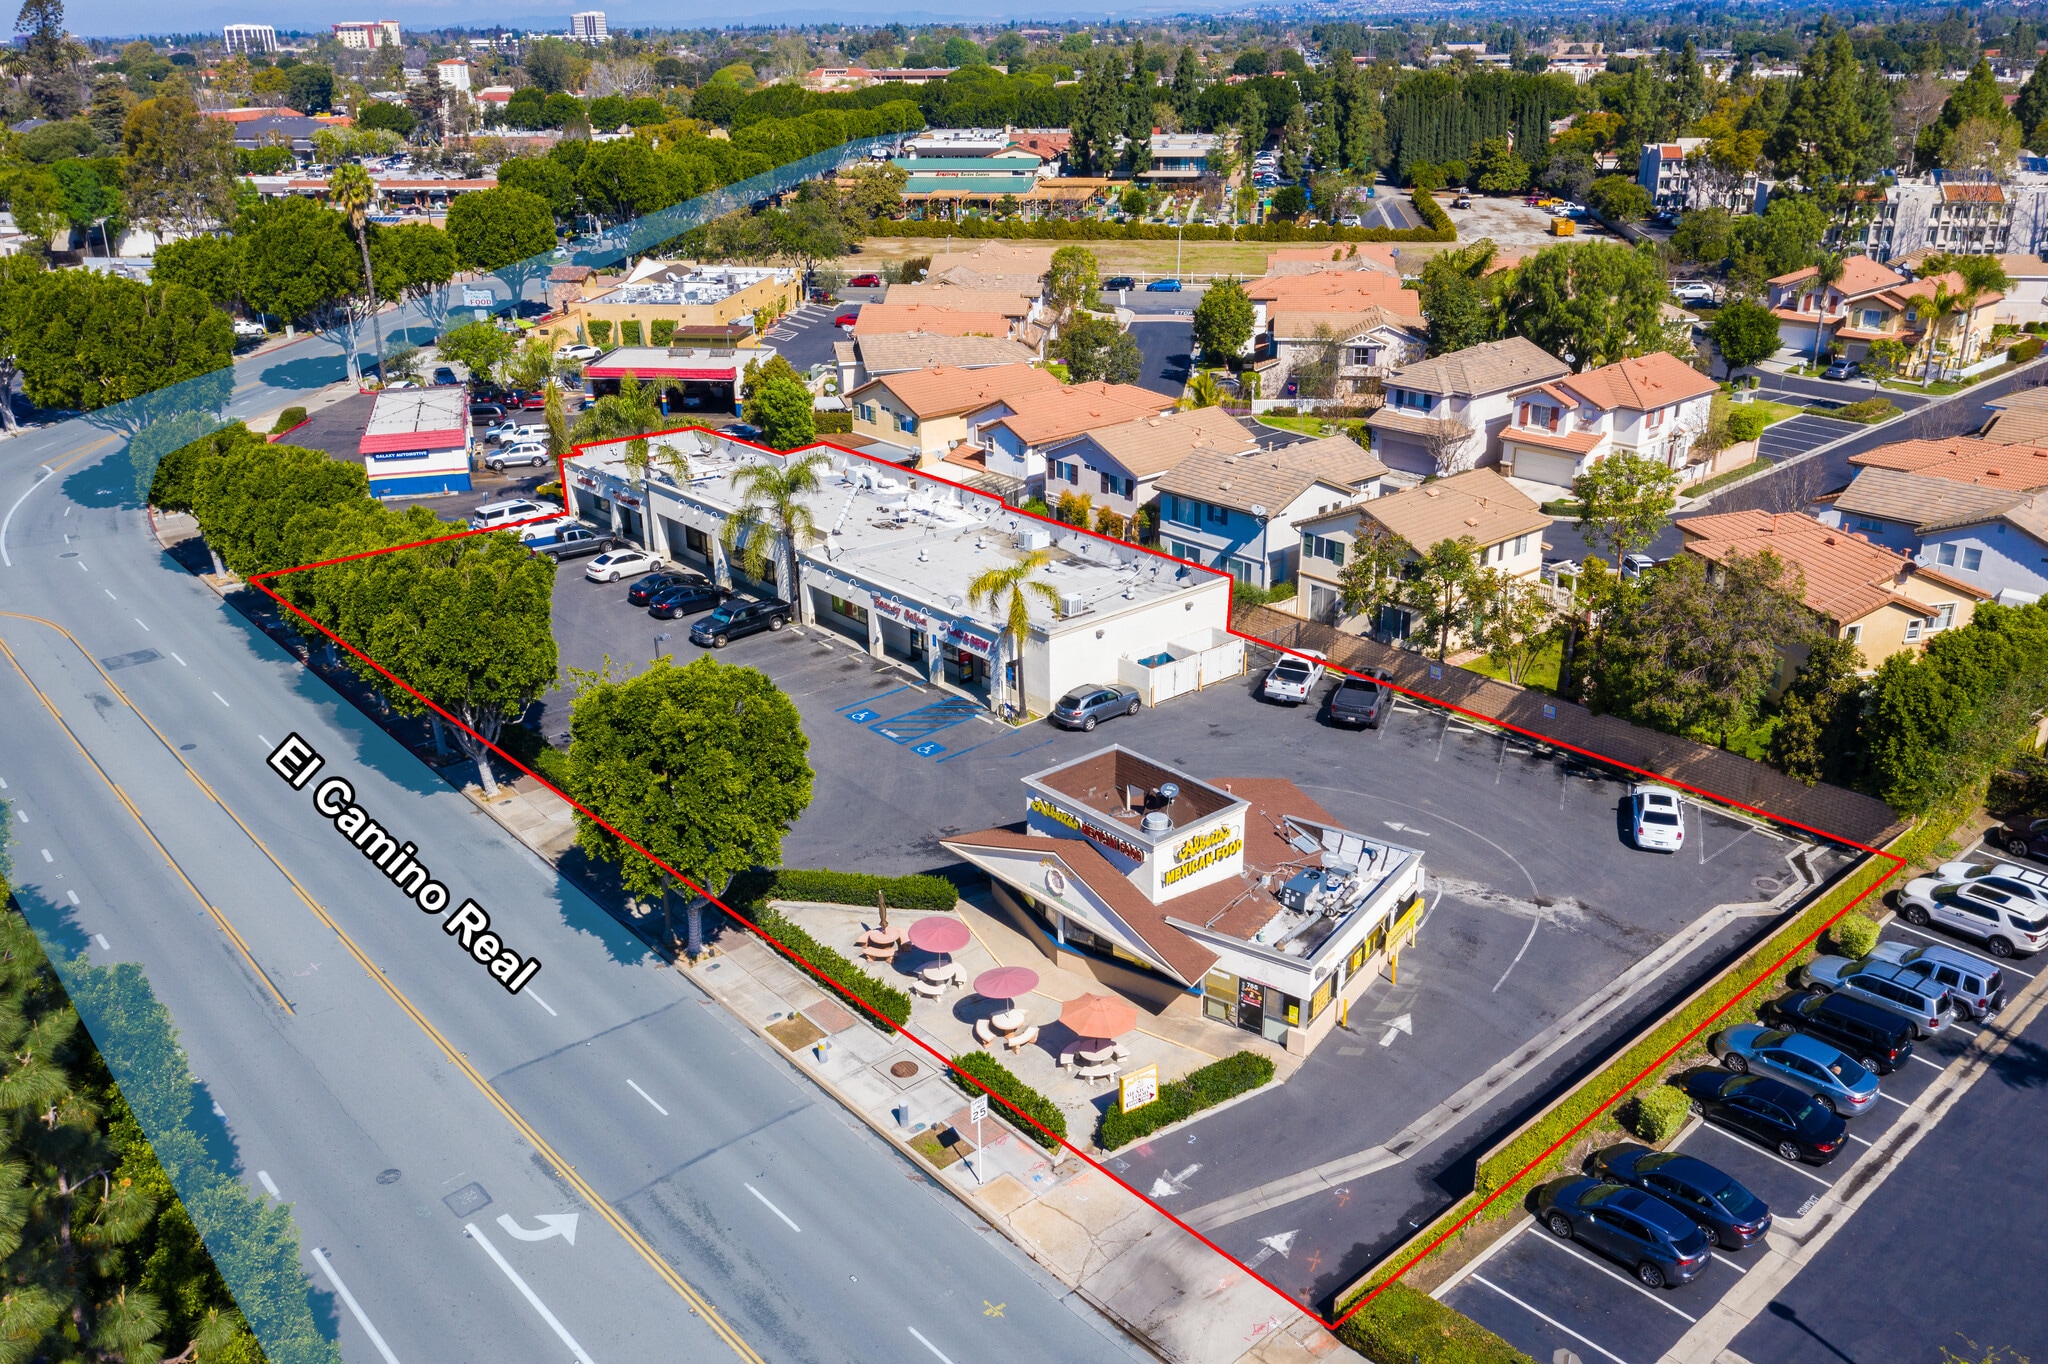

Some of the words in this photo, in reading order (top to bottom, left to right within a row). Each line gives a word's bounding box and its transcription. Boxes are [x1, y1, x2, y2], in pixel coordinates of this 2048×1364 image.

[1081, 822, 1121, 851] MEXICAN
[1119, 840, 1145, 863] FOOD
[1177, 825, 1231, 860] Alberto's
[1164, 851, 1215, 886] MEXICAN
[1214, 838, 1243, 862] FOOD
[972, 1096, 986, 1107] SPEED
[972, 1107, 986, 1121] 25
[1796, 1193, 1820, 1216] COMPACT
